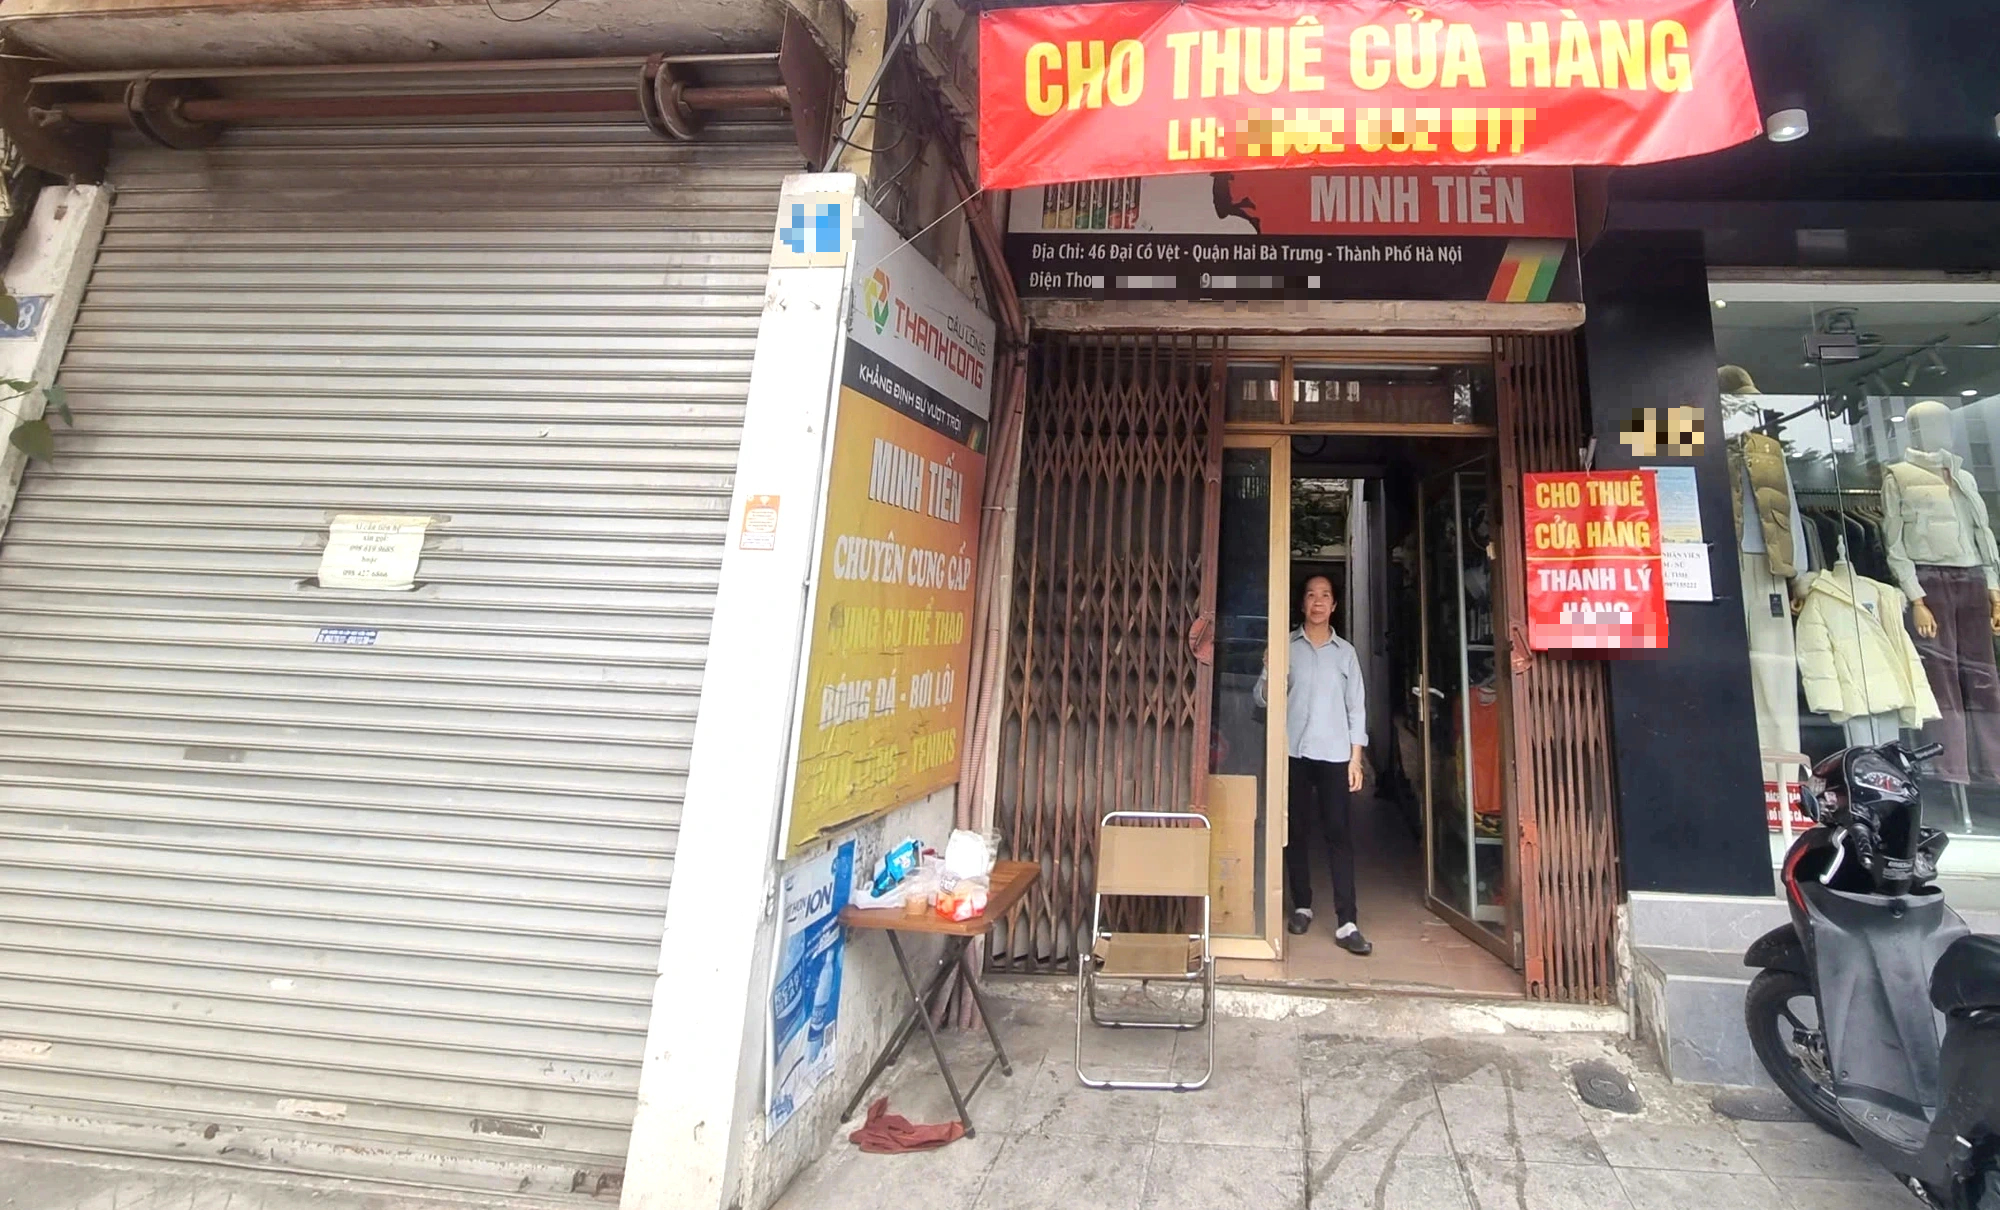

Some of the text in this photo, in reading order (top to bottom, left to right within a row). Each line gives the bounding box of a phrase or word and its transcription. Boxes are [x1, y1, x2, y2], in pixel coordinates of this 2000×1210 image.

[1025, 8, 1693, 116] CHO THUÊ CỬA HÀNG
[1167, 117, 1225, 160] LH:
[1310, 175, 1420, 223] MINH
[1032, 243, 1055, 262] Địa
[1058, 242, 1085, 260] Chỉ:
[1088, 244, 1106, 260] 46
[1109, 243, 1133, 263] Đại
[1192, 244, 1229, 263] Quận
[1233, 245, 1256, 261] Hai
[1260, 244, 1278, 261] Bà
[1281, 245, 1324, 264] Trưng
[1336, 244, 1381, 262] Thành
[1384, 243, 1412, 262] Phố
[1415, 245, 1434, 262] Hà
[1438, 245, 1463, 265] Nội
[1029, 271, 1061, 291] Điện
[1066, 271, 1096, 288] Tho
[893, 382, 915, 406] ĐỊNH
[868, 437, 964, 525] MINH TIẾN
[1535, 474, 1645, 509] CHO THUÊ
[1534, 514, 1651, 550] CỬA HÀNG
[833, 530, 971, 591] CHUYÊN CUNG CẤP
[1537, 563, 1653, 592] THANH LÝ
[934, 609, 964, 646] THAO
[909, 669, 934, 711] BƠI
[935, 663, 956, 712] LỘI
[805, 882, 833, 918] ION
